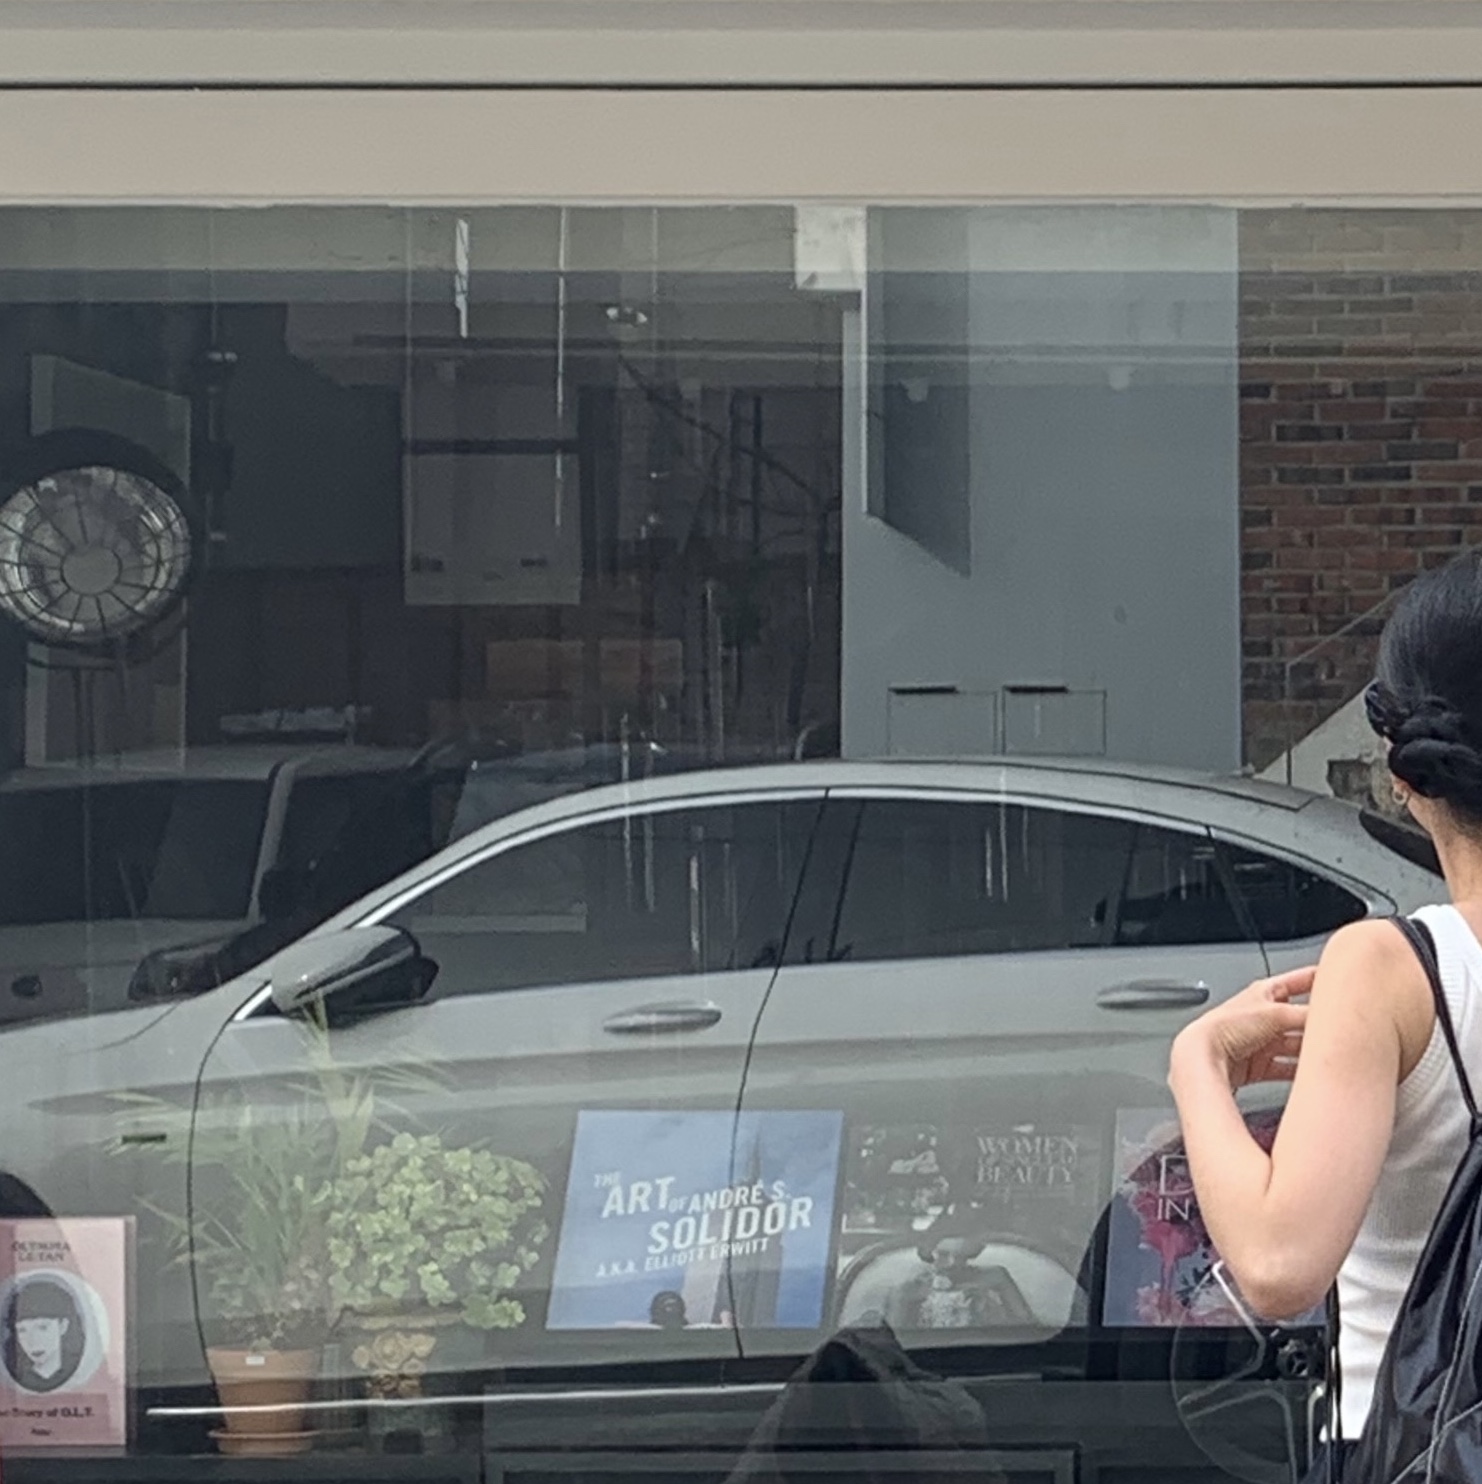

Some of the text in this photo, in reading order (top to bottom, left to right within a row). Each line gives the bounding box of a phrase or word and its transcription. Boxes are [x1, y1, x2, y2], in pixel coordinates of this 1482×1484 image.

[977, 1135, 1078, 1155] WOMEN
[593, 1171, 622, 1188] THE
[601, 1176, 676, 1219] ART
[647, 1195, 814, 1255] SOLIDOR
[710, 1236, 769, 1261] ERWITT
